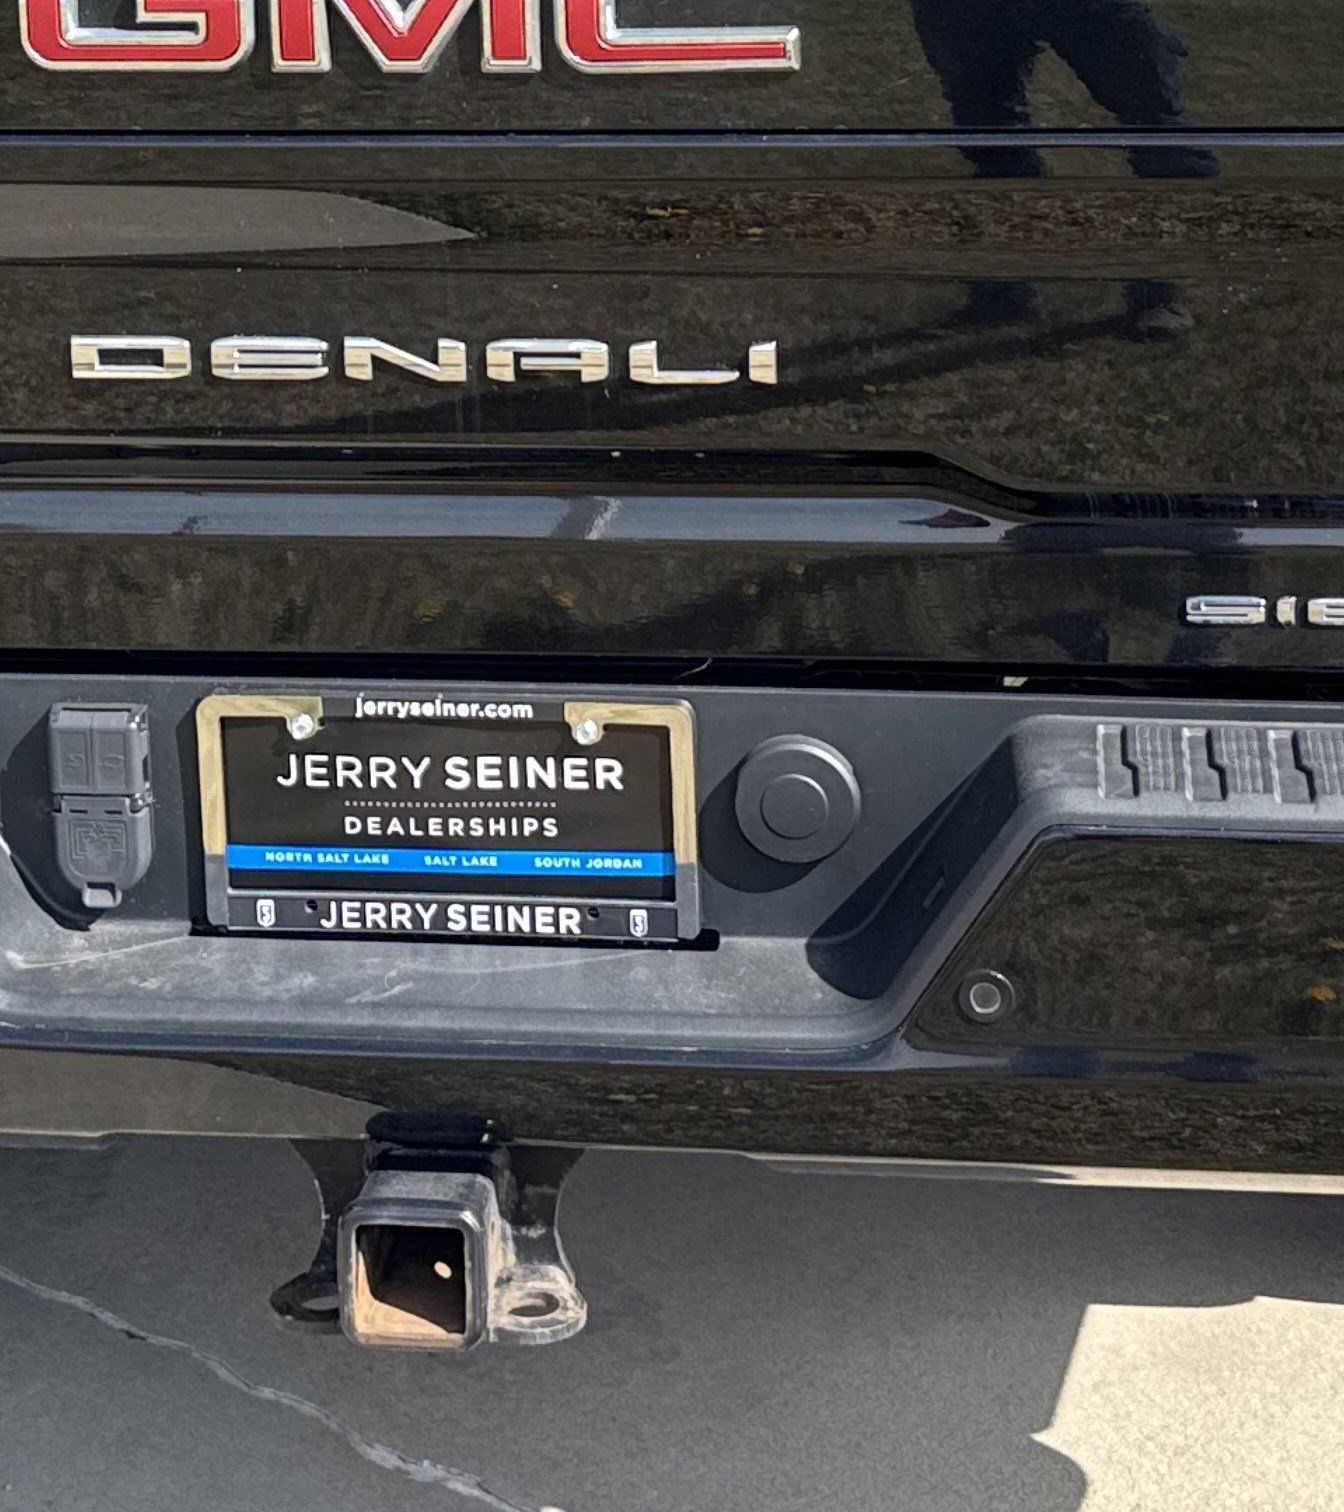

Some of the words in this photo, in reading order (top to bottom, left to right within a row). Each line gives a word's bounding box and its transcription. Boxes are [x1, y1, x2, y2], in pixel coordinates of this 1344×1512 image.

[71, 334, 778, 384] DENALI
[355, 692, 534, 719] jerryseiner.com
[276, 753, 431, 789] JERRY
[444, 756, 625, 790] SEINER
[344, 815, 558, 838] DEALERSHIPS
[265, 851, 313, 863] NORTH
[317, 852, 349, 864] SALT
[353, 853, 390, 865] LAKE
[423, 855, 457, 866] SALT
[461, 855, 498, 867] LAKE
[534, 856, 581, 869] SOUTH
[585, 857, 644, 870] JORDAN
[320, 900, 438, 930] JERRY
[446, 904, 582, 934] SEINER
